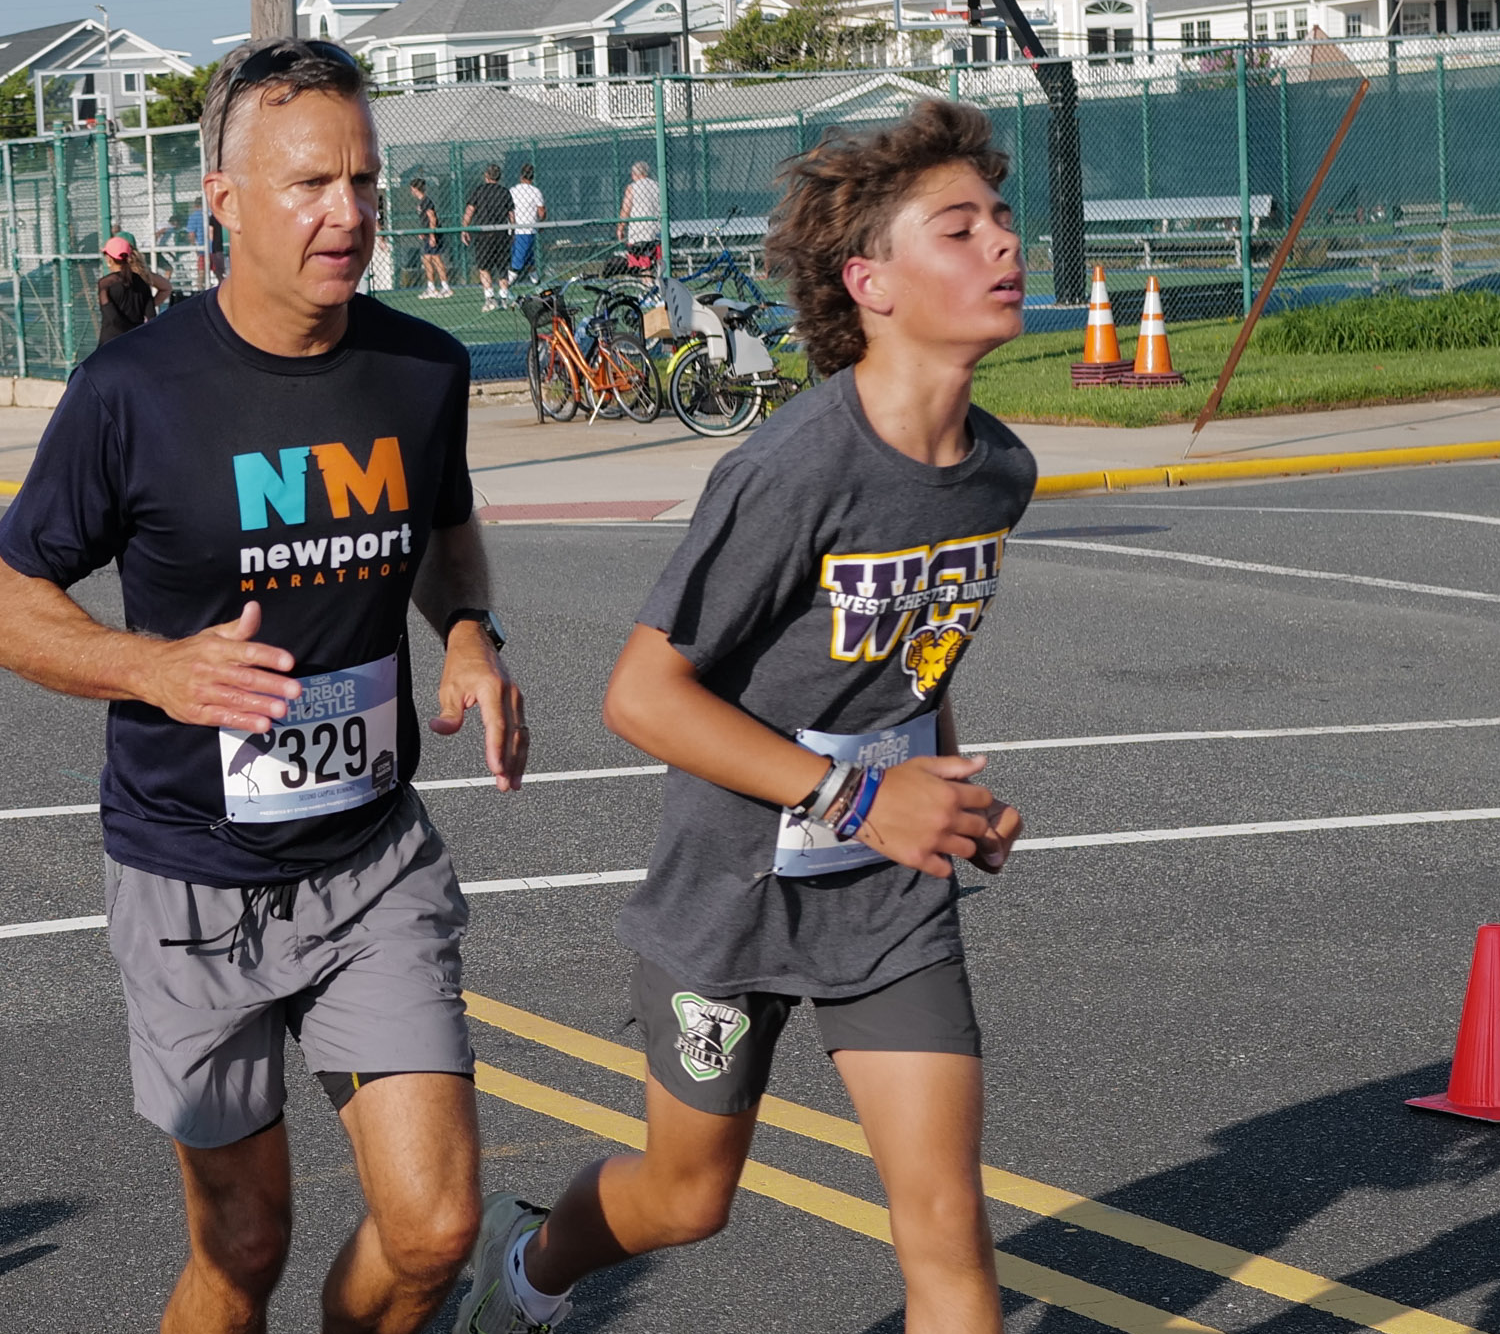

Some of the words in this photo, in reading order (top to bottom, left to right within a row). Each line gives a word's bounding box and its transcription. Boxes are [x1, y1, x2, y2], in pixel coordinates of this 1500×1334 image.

[233, 437, 409, 531] NM
[240, 523, 412, 574] newport
[241, 562, 408, 592] MARATHON
[829, 591, 891, 615] WEST
[894, 584, 959, 612] CHESTER
[287, 695, 356, 722] HUSTLE
[278, 716, 367, 788] 329
[857, 735, 910, 761] HARBOR
[674, 1033, 736, 1074] PHILLY
